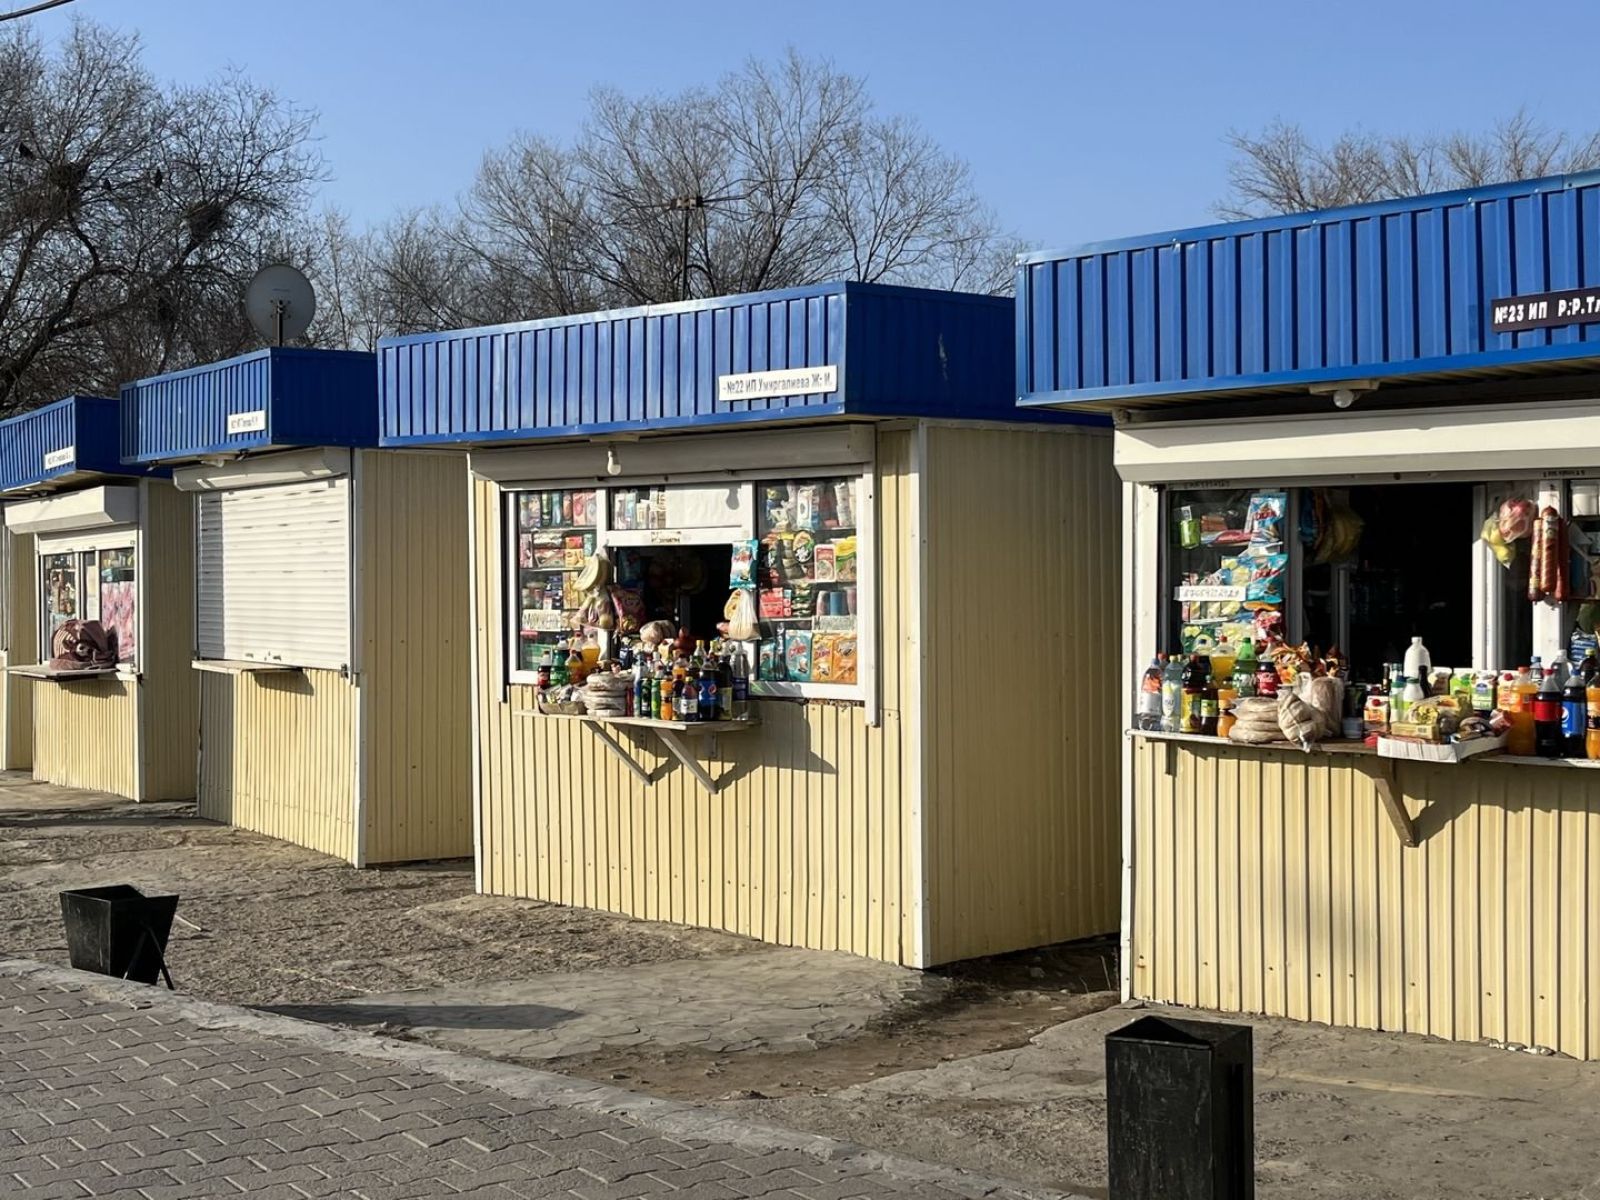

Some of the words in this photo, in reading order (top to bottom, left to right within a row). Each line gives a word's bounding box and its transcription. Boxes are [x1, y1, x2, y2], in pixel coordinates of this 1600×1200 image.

[1495, 305, 1524, 324] №23
[1529, 302, 1548, 320] ИП
[746, 379, 757, 393] ИП
